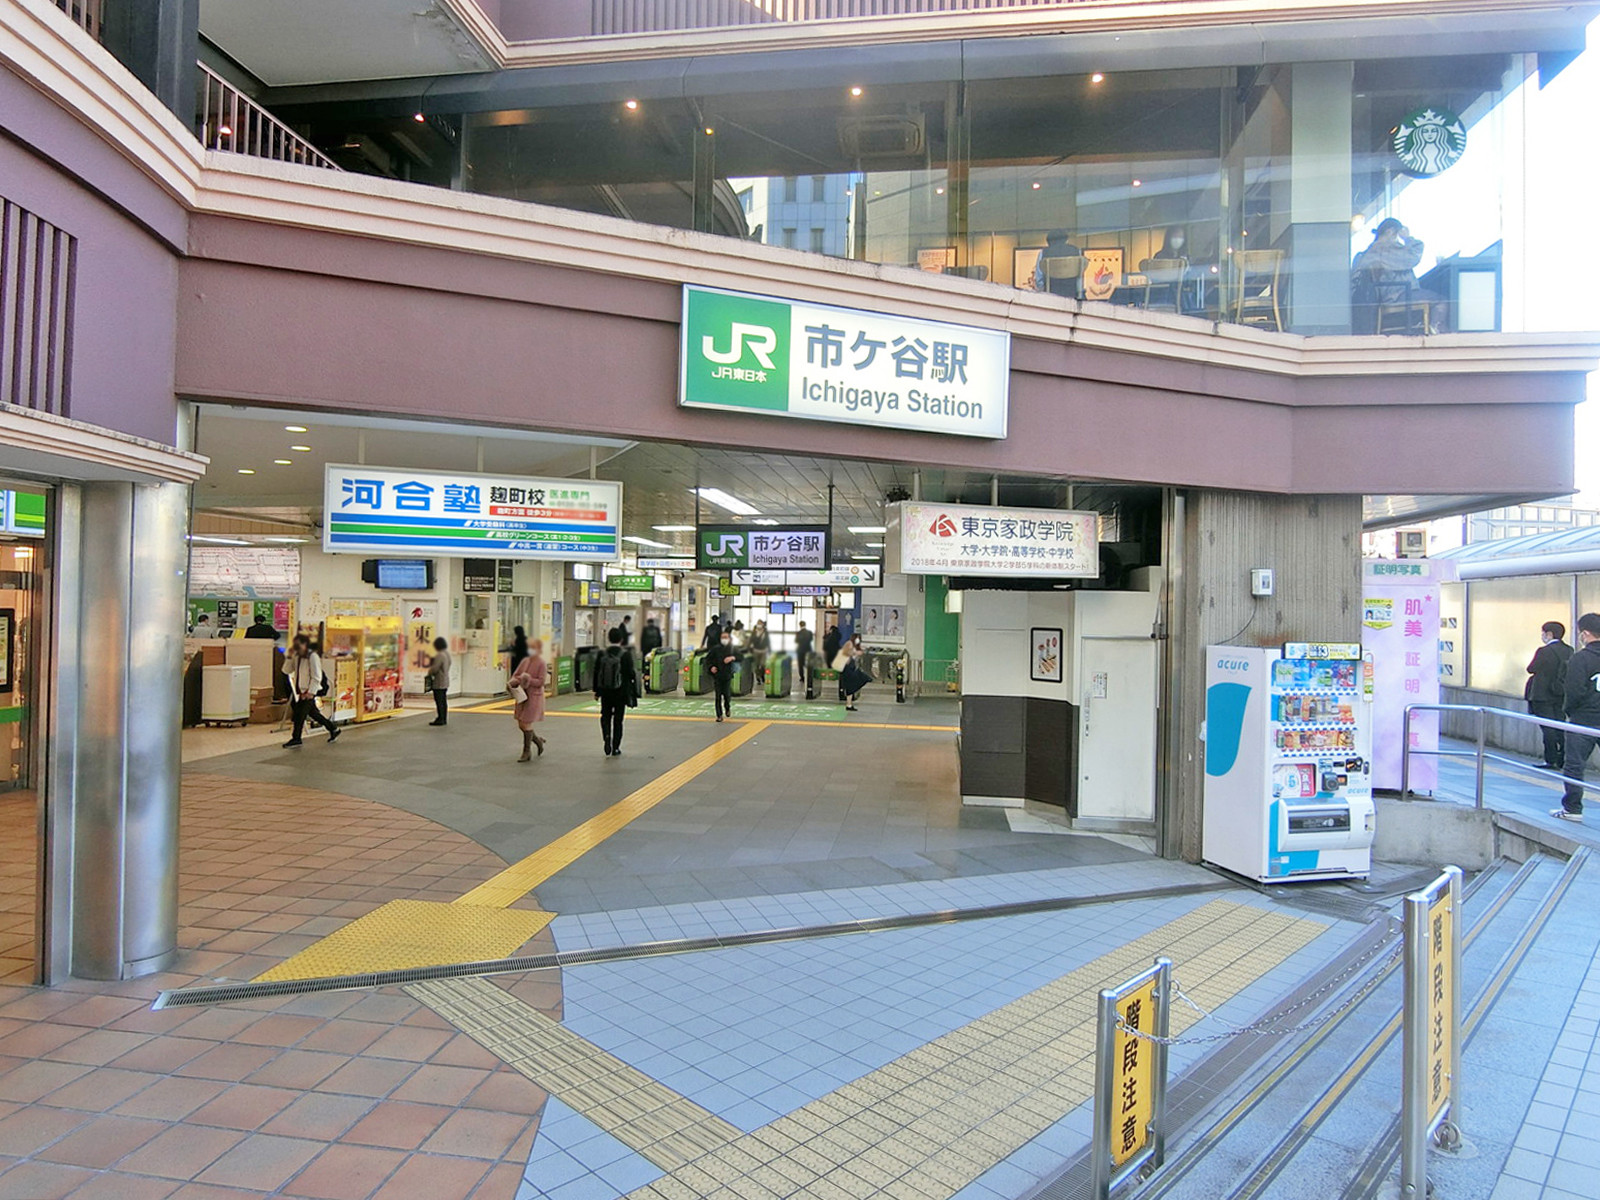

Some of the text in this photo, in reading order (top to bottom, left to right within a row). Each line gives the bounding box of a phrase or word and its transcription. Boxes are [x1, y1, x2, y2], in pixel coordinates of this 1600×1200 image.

[702, 322, 776, 370] JR
[804, 324, 968, 385] 市ケ谷駅
[711, 366, 767, 384] JR東日本
[802, 376, 983, 420] Ichigaya Station
[341, 478, 481, 514] 河合塾
[961, 516, 1074, 542] 東京家政学院
[705, 534, 745, 557] JR
[752, 554, 819, 566] Ichigaya Station
[1373, 564, 1422, 576] 証明写真
[1217, 658, 1249, 672] acure
[1121, 999, 1142, 1155] 階段注意
